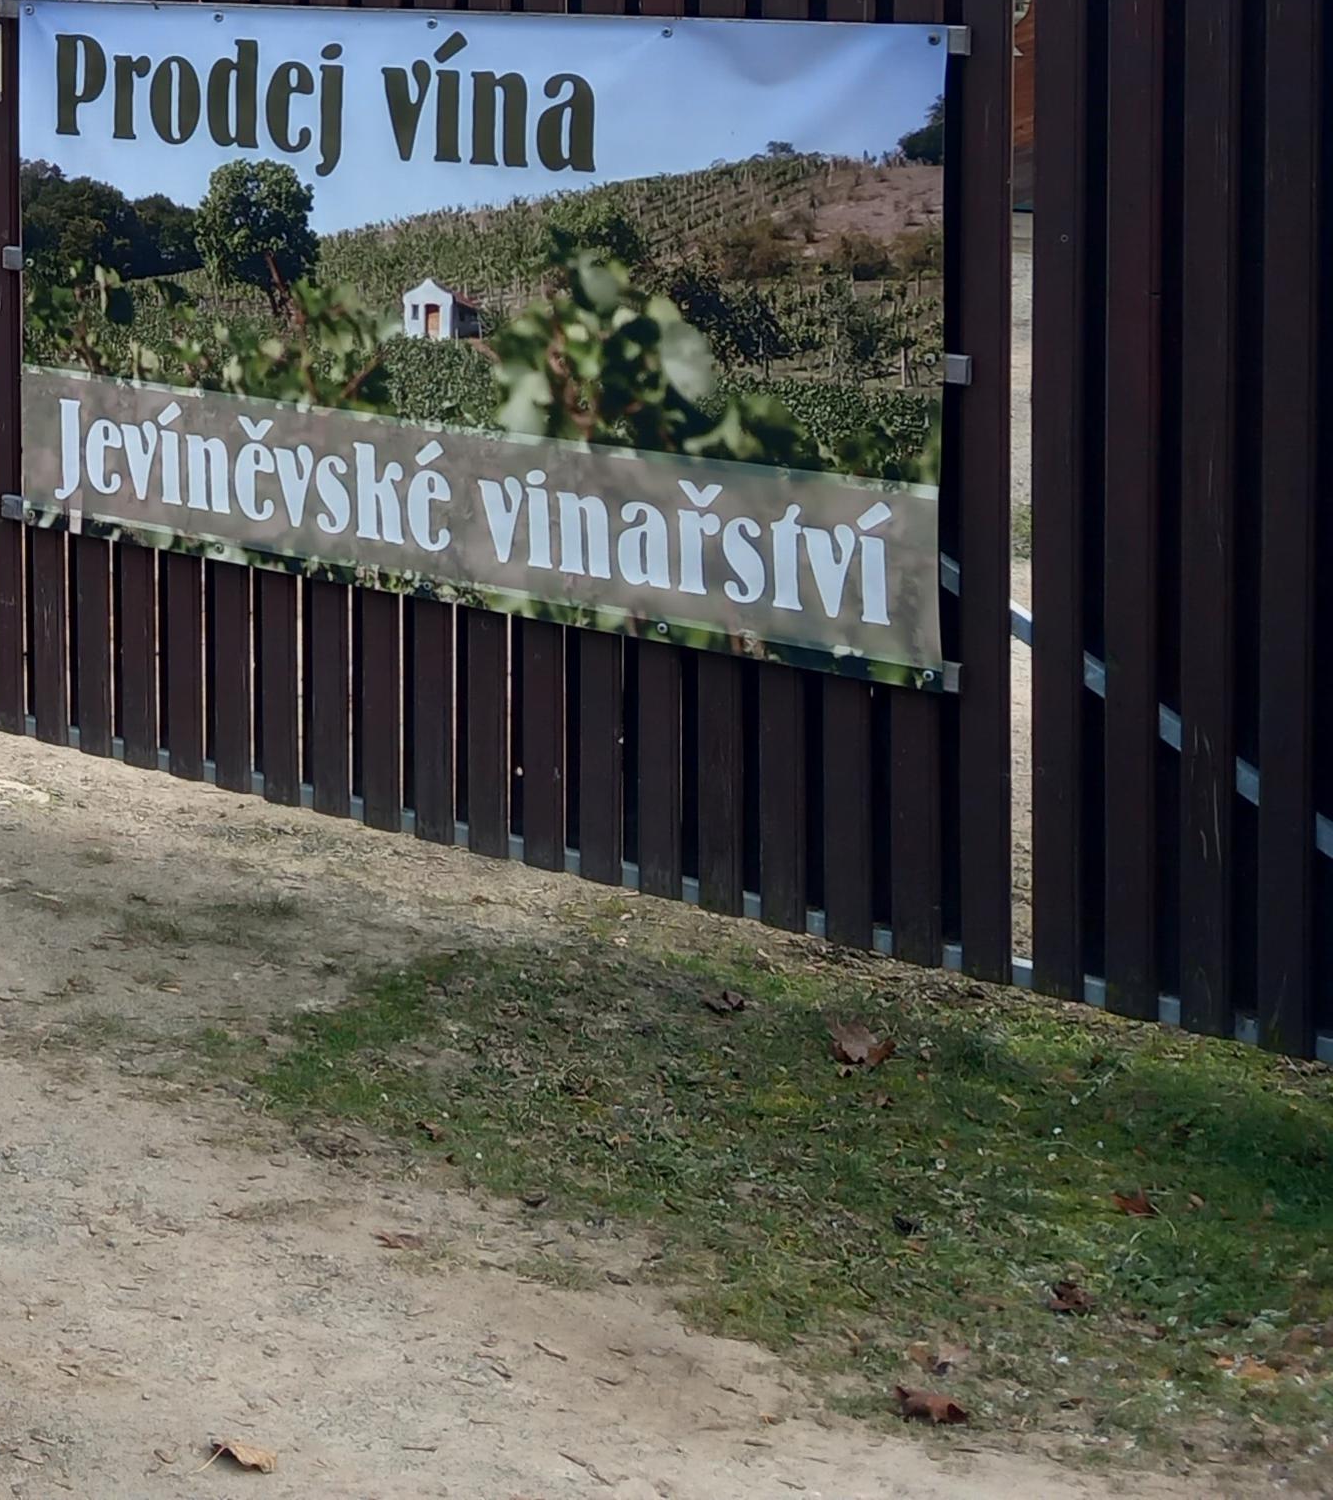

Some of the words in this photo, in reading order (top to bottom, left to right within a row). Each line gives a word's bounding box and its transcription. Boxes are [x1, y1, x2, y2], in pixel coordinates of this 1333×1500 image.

[55, 32, 344, 177] Prodej
[382, 31, 597, 173] vína
[54, 398, 452, 553] Jevíněvské
[478, 468, 893, 627] vinařství
